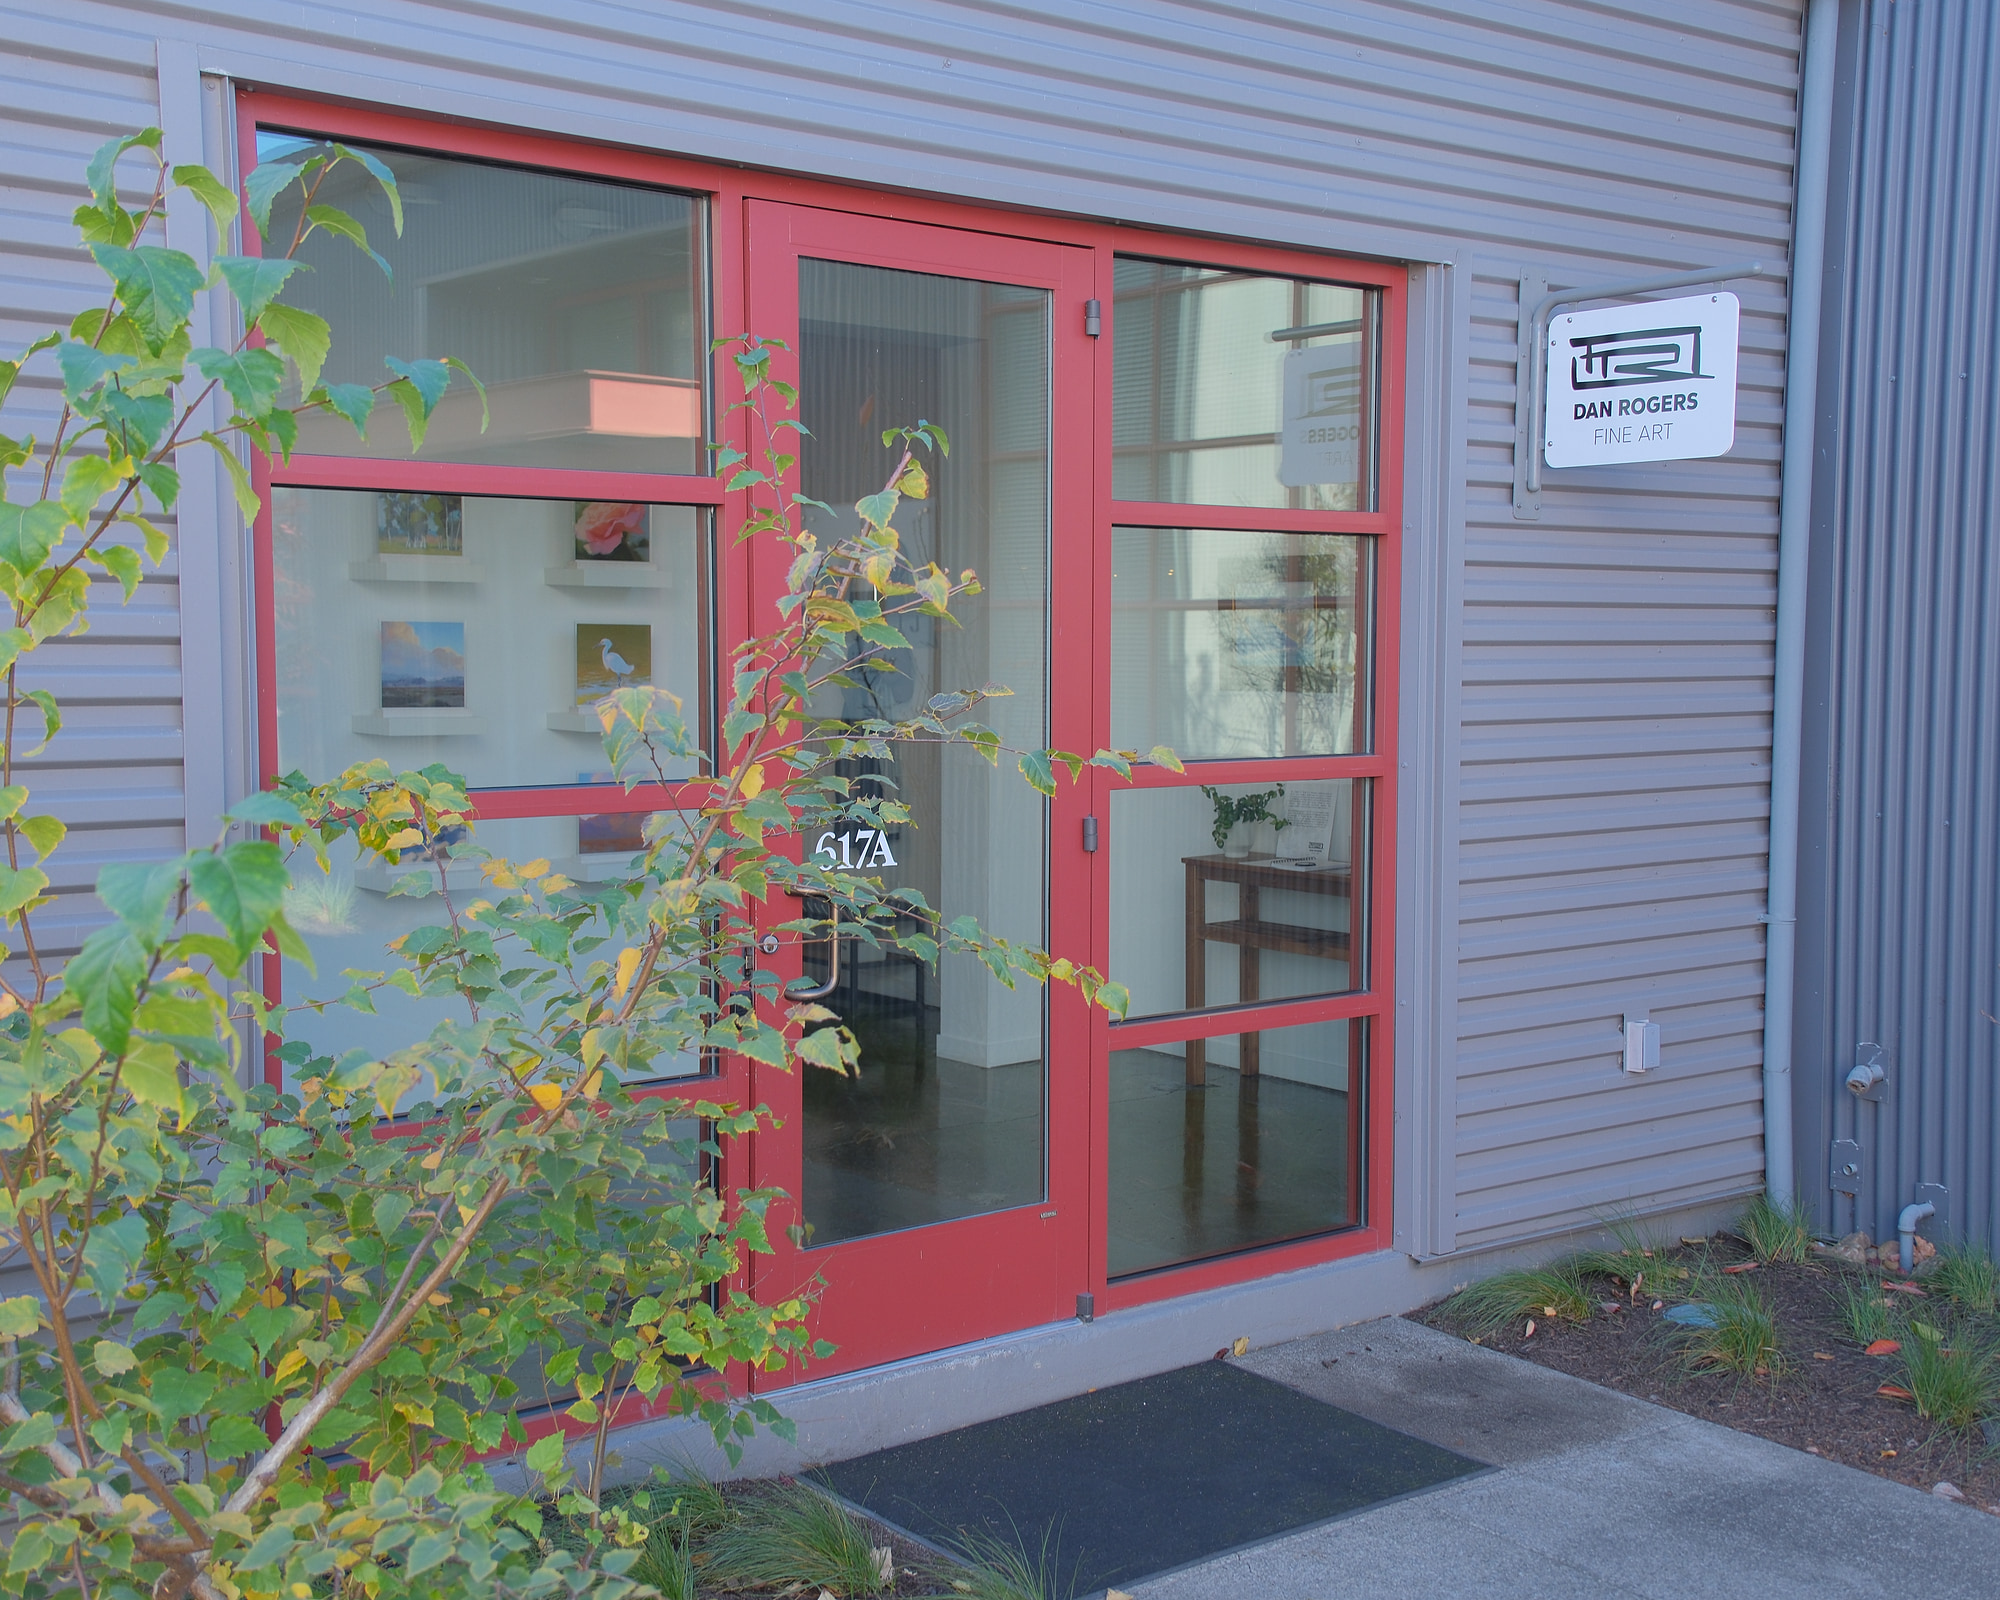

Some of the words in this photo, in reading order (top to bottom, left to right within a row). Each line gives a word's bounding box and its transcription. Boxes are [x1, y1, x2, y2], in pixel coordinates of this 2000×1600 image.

[1574, 401, 1612, 420] DAN
[1618, 392, 1698, 416] ROGERS
[1594, 426, 1632, 445] FINE
[1638, 423, 1673, 442] ART
[815, 829, 898, 871] 617A
